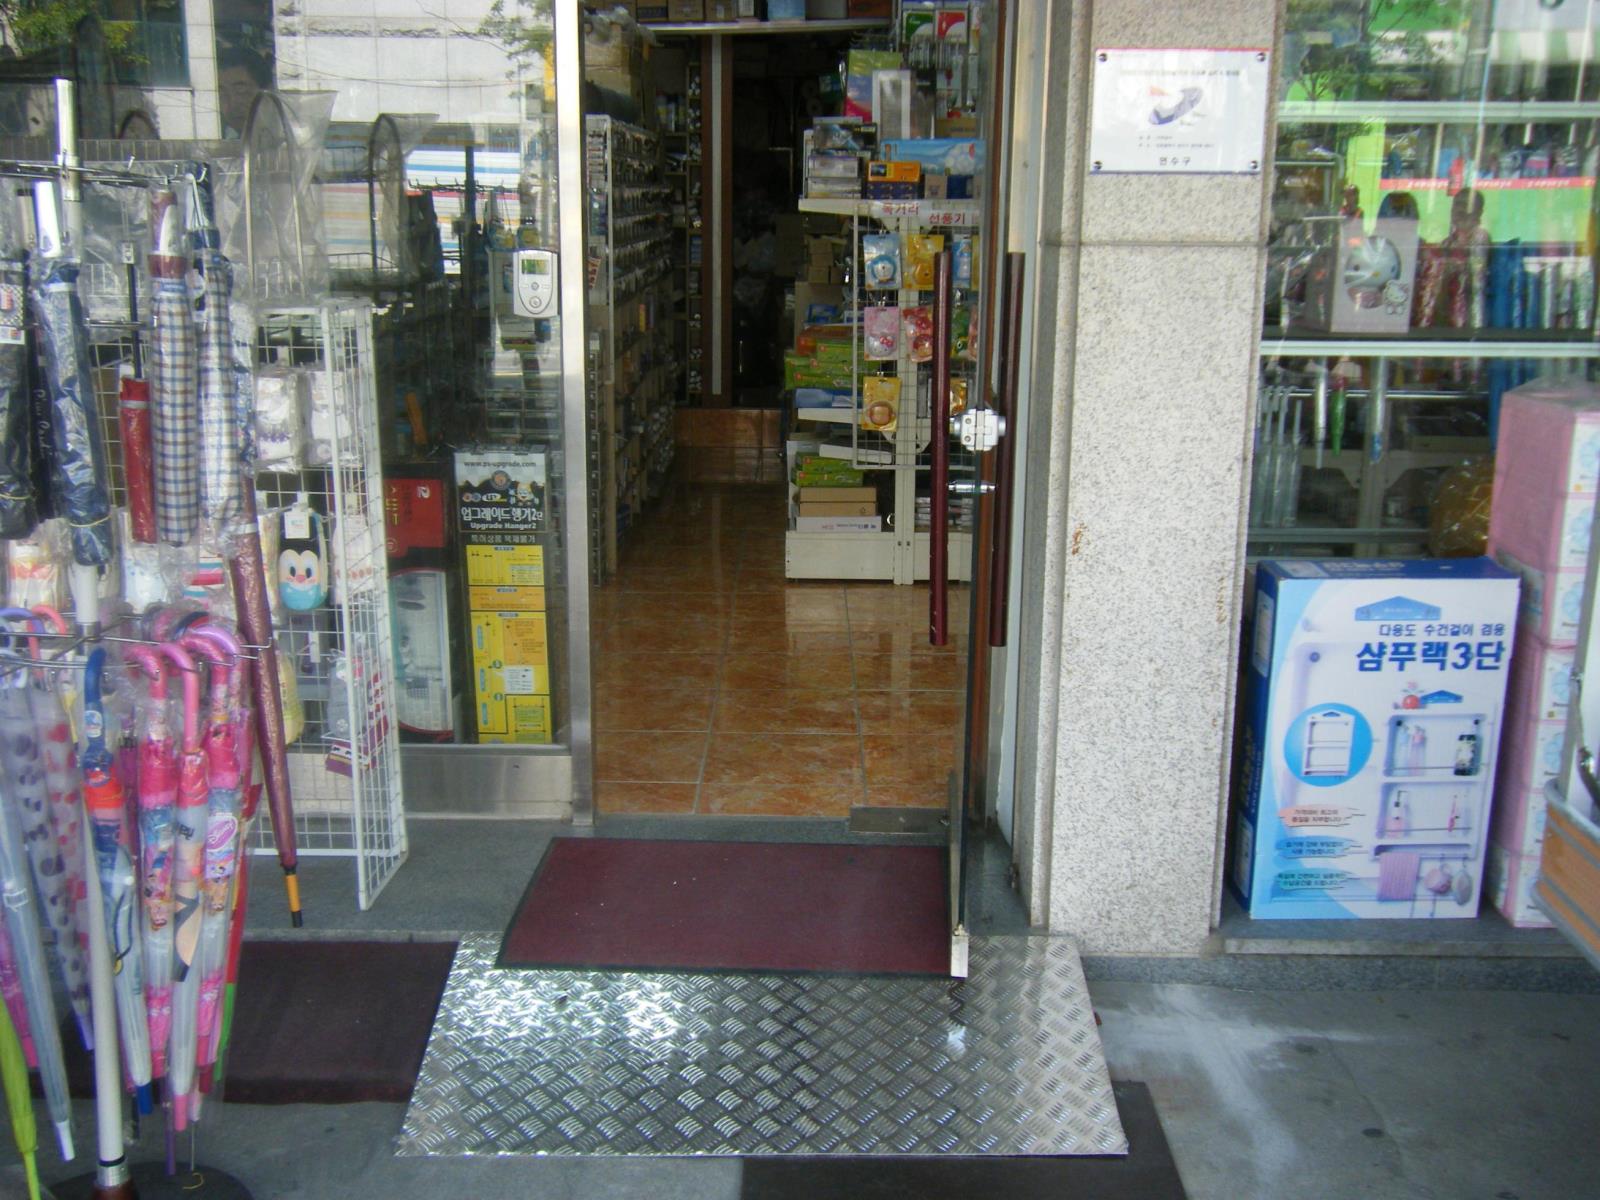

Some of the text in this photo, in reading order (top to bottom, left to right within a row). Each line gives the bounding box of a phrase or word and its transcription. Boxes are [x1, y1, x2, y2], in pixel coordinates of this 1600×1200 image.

[928, 212, 966, 225] 선풍기
[461, 506, 512, 522] 업그레이드
[470, 522, 537, 531] Upgrade Hanger2
[1379, 624, 1505, 637] 다용도 수건걸이 겸용
[1356, 640, 1505, 672] 샴푸랙3단
